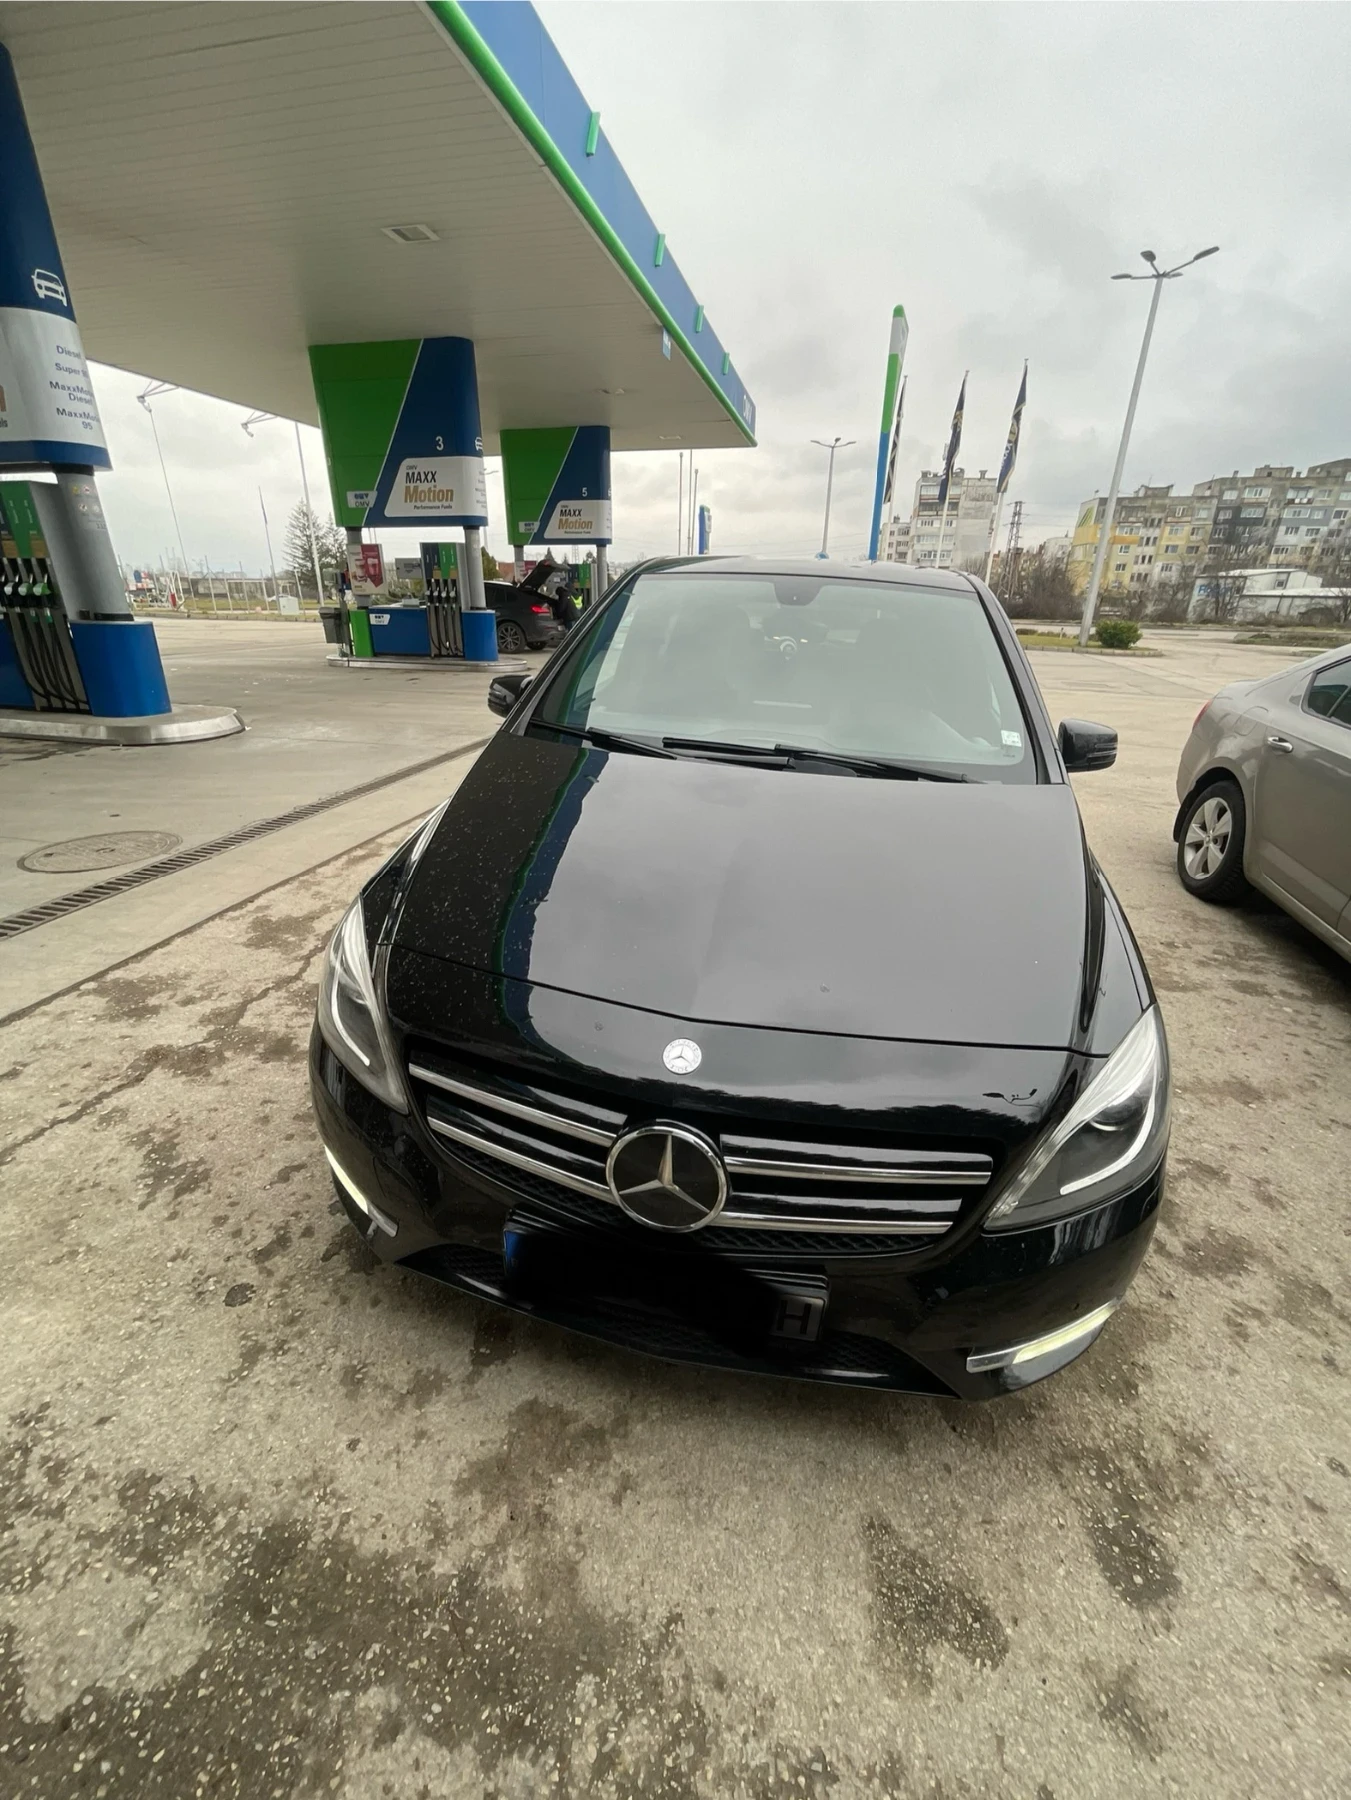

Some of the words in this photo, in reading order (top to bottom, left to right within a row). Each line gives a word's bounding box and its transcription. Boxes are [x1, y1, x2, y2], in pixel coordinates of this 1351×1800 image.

[56, 345, 82, 359] Diesel
[55, 363, 80, 375] Super
[68, 393, 93, 405] Diesel
[81, 421, 93, 430] 95
[435, 436, 444, 451] 3
[405, 471, 437, 484] MAXX
[404, 485, 454, 503] Motion
[582, 487, 588, 497] 5
[560, 508, 582, 517] MAXX
[558, 518, 593, 530] Motion
